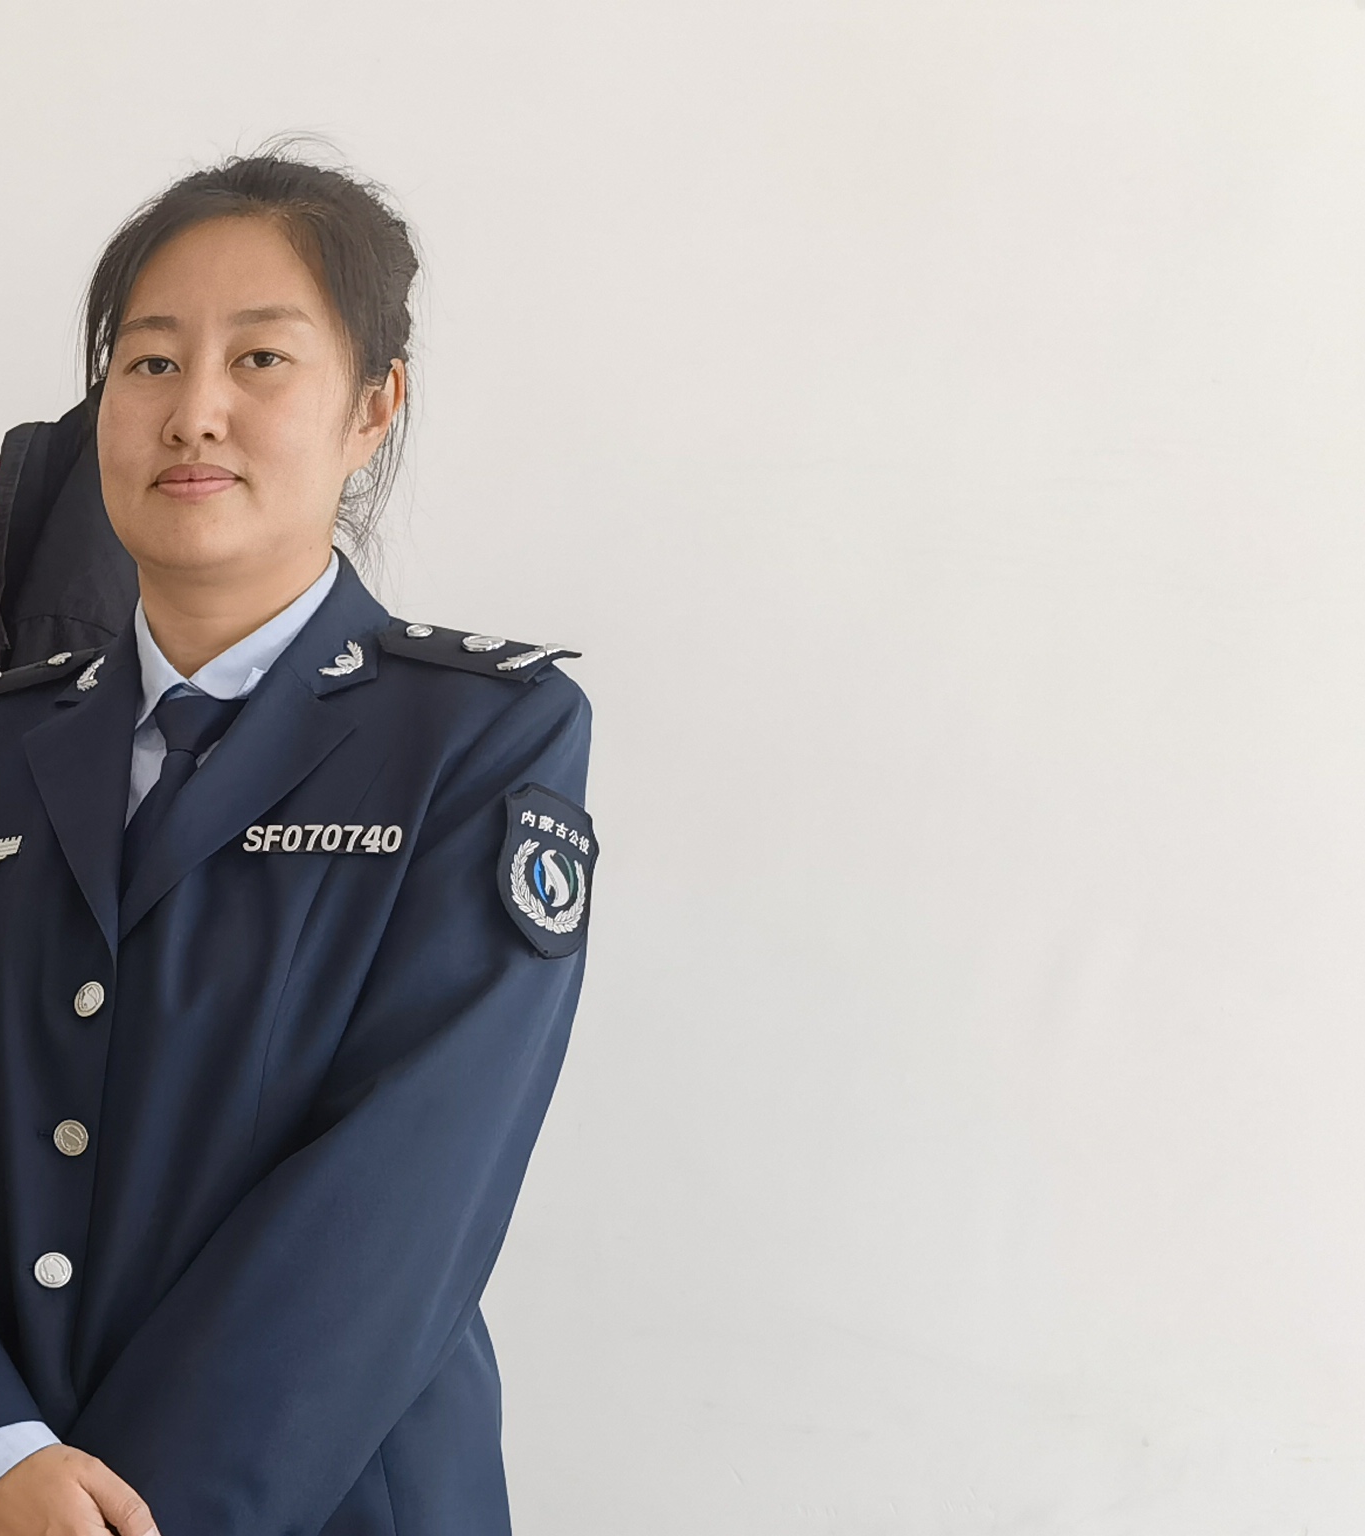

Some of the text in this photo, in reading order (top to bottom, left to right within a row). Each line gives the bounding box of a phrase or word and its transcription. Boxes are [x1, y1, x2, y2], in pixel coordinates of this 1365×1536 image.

[242, 824, 403, 853] SF070740
[520, 810, 591, 855] 内蒙古公投
